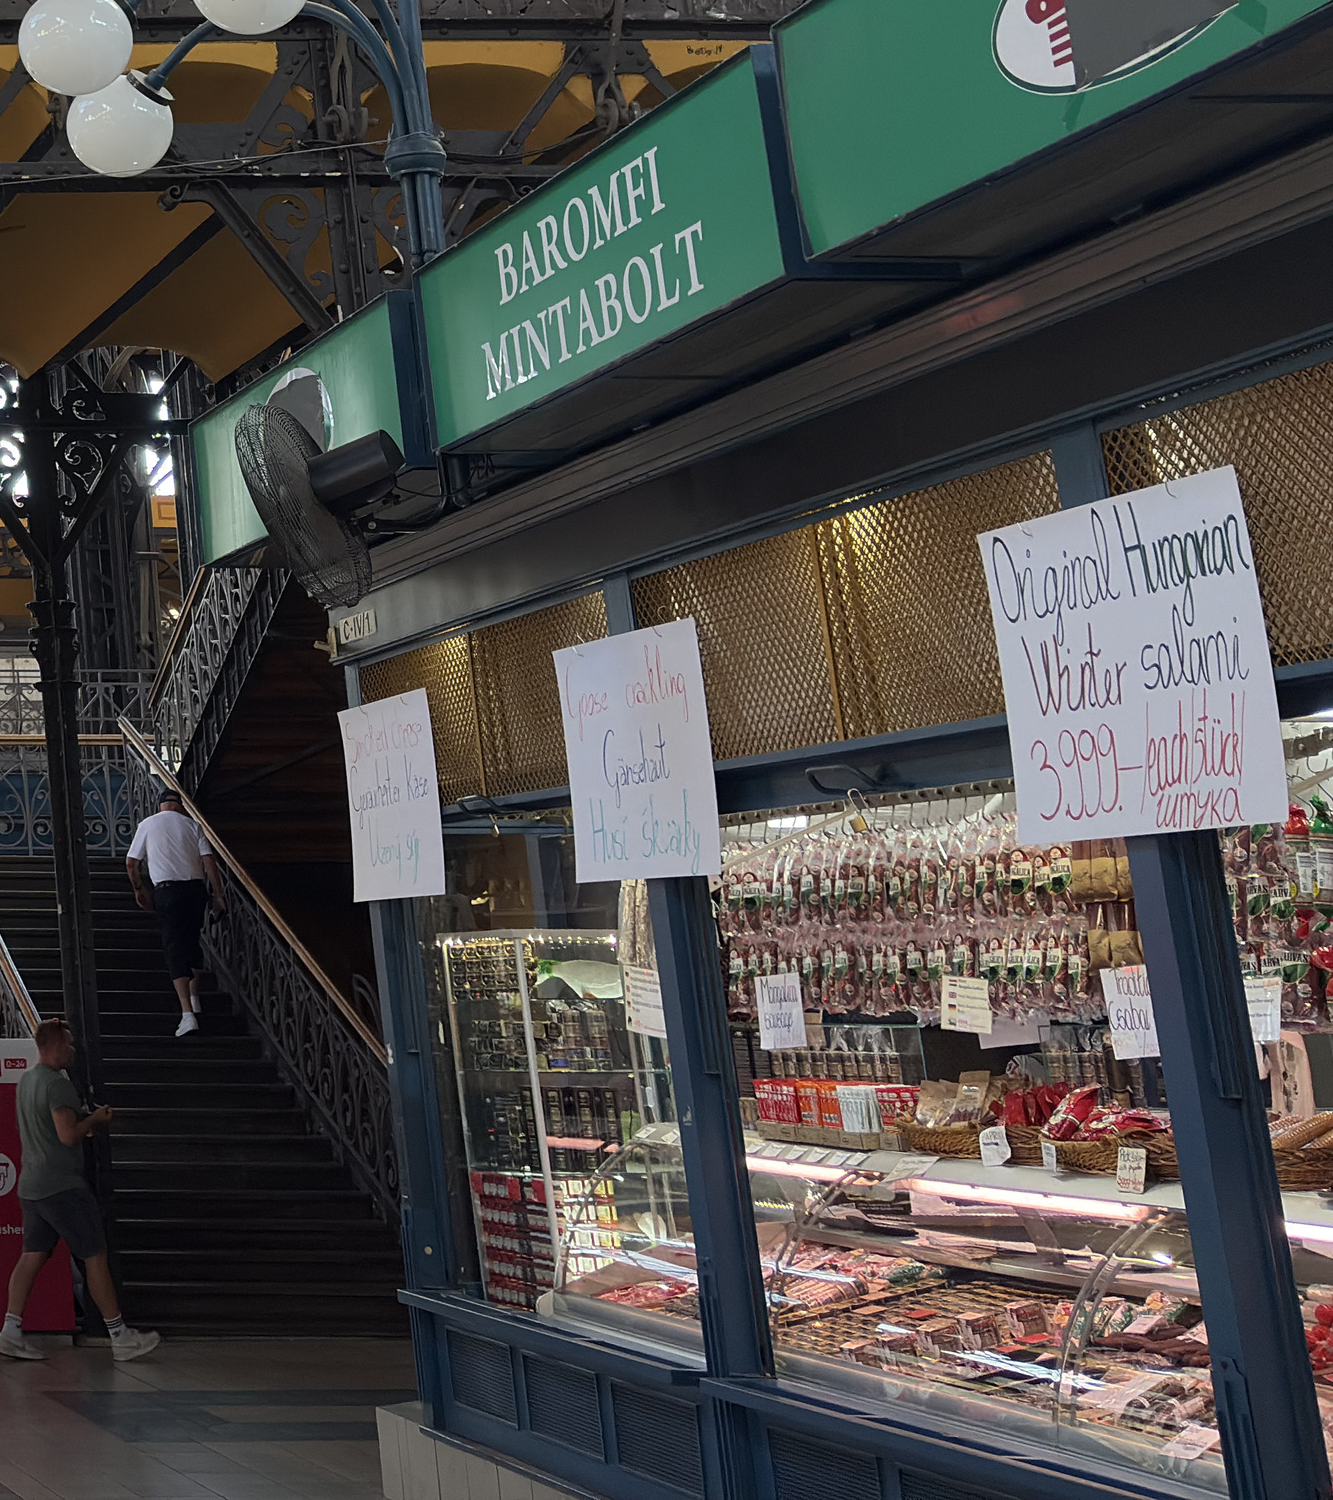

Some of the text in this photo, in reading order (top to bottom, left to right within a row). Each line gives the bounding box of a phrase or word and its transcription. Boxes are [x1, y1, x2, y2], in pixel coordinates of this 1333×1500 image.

[495, 146, 666, 306] BAROMFI
[481, 221, 706, 402] MINTABOLT
[991, 500, 1251, 647] Original Hungarian
[1020, 603, 1251, 717] Winter salami
